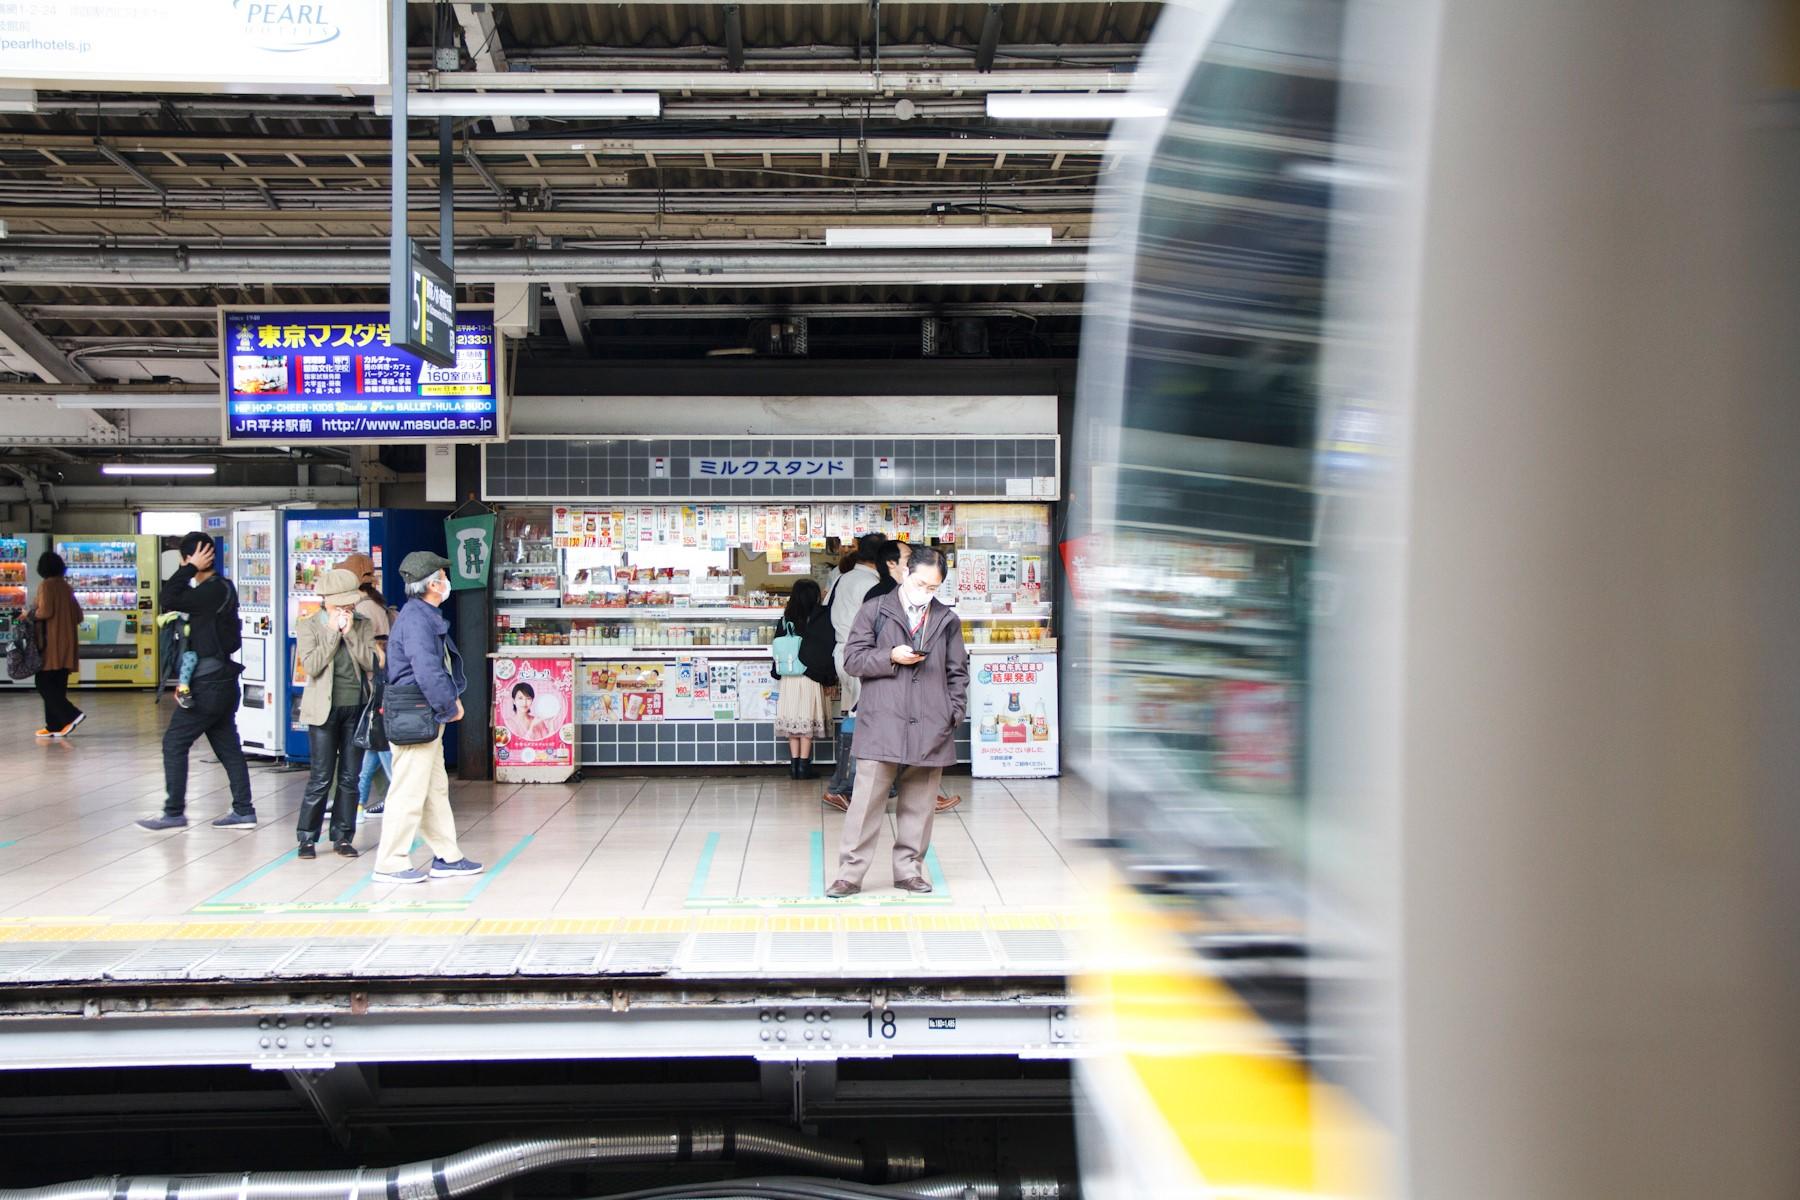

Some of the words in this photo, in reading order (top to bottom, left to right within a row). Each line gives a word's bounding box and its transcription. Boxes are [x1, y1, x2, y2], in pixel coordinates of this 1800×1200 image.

[247, 3, 328, 25] PEARL
[0, 37, 93, 53] pearlhotels.jp
[413, 270, 421, 330] 5
[455, 334, 492, 345] 2)3331
[427, 372, 483, 382] 160室直結
[236, 418, 312, 432] JR平井駅前
[321, 417, 492, 431] http://www.masuda.ac.jp
[700, 460, 843, 475] ミルクスタンド
[464, 538, 484, 574] 青汁
[958, 583, 971, 591] 250
[973, 583, 986, 591] 500
[113, 662, 139, 670] acure
[992, 672, 1036, 682] 結果発表
[861, 1010, 898, 1039] 18
